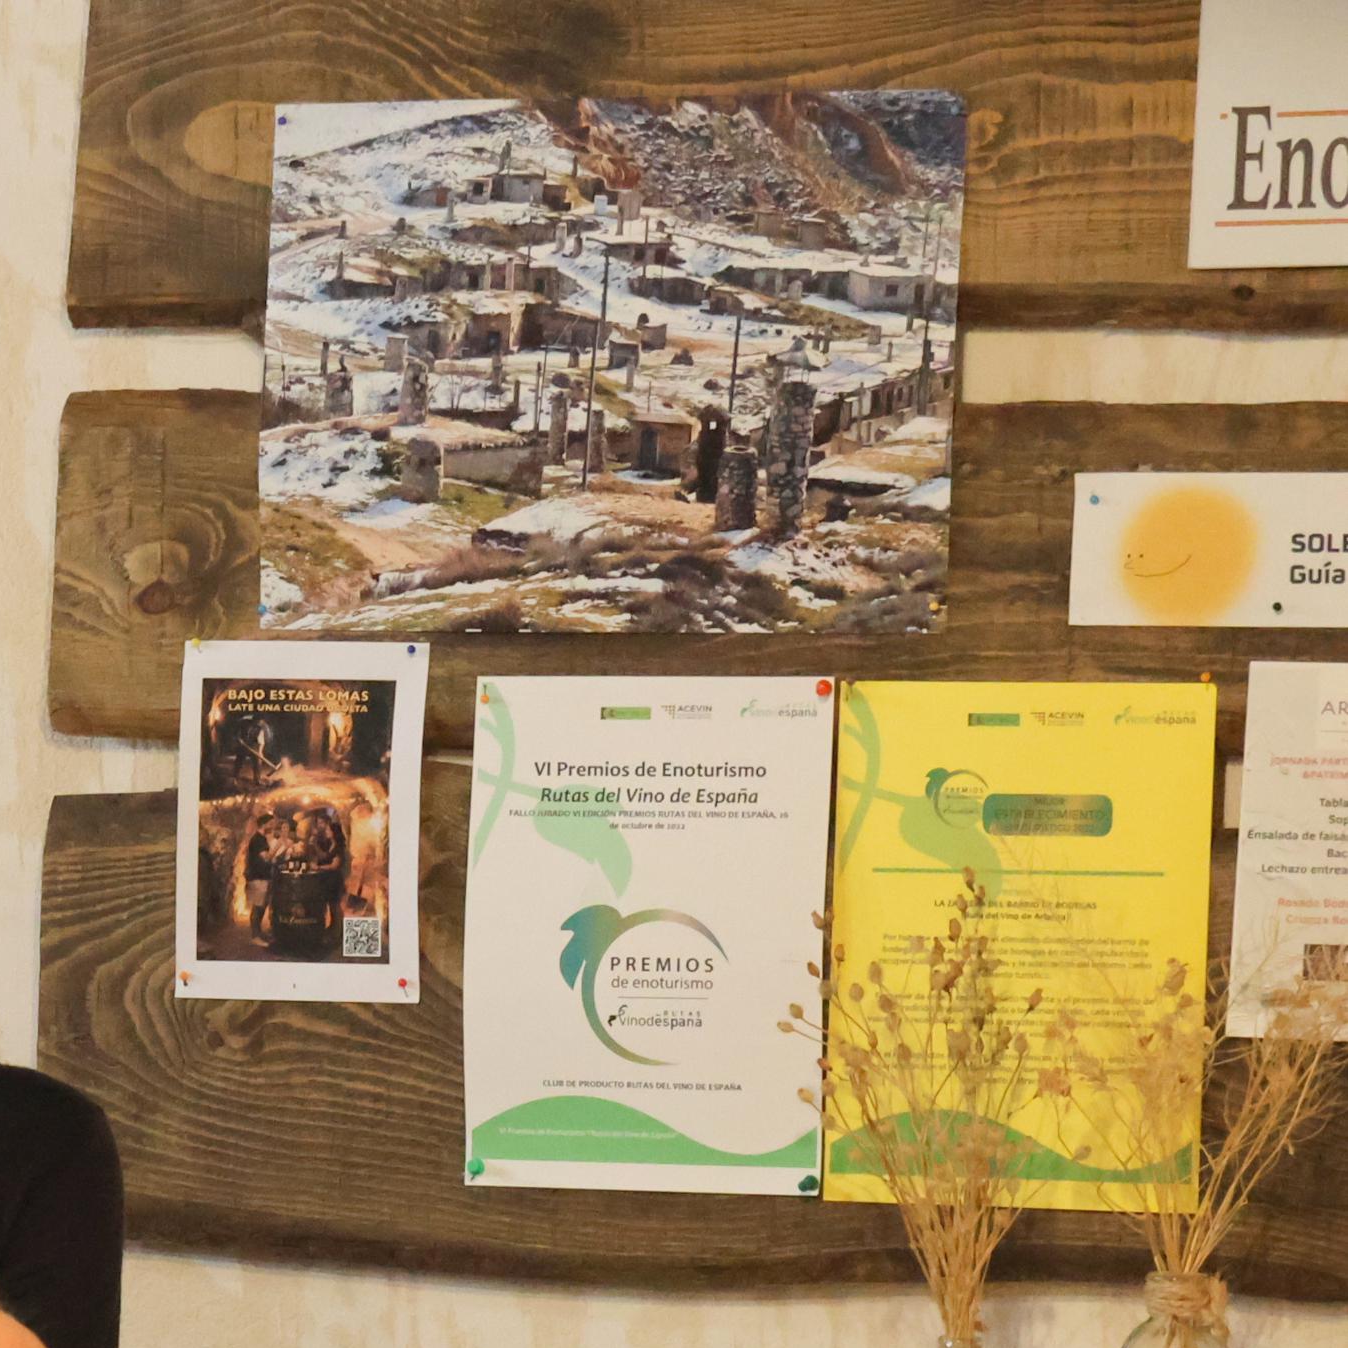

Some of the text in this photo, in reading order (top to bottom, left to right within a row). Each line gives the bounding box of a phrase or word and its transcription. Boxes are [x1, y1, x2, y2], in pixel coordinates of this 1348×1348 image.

[1290, 561, 1346, 584] Guía
[228, 689, 369, 702] BAJO ESTAS LOMAS
[228, 703, 254, 712] LATE
[257, 704, 280, 712] UNA
[283, 704, 323, 713] CIUDAD
[677, 704, 713, 713] ACEVIN
[1321, 701, 1348, 715] AR
[1048, 711, 1085, 719] ACEVIN
[534, 761, 767, 778] VI Premios de Enoturismo
[540, 787, 759, 807] Rutas del Vino de España
[509, 809, 535, 818] FALLO
[618, 809, 656, 818] PREMIOS
[658, 810, 686, 819] RUTAS
[688, 810, 703, 818] DEL
[706, 810, 727, 818] VINO
[728, 810, 740, 818] DE
[609, 822, 619, 830] de
[655, 822, 665, 830] de
[1247, 830, 1299, 841] Ensalada
[1302, 832, 1317, 841] de
[1261, 864, 1307, 874] Lechazo
[610, 957, 714, 973] PREMIOS
[611, 976, 714, 990] de enoturismo
[543, 1079, 564, 1088] CLUB
[566, 1079, 576, 1088] DE
[579, 1080, 624, 1089] PRODUCTO
[627, 1081, 654, 1090] RUTAS
[656, 1081, 672, 1090] DEL
[673, 1082, 694, 1091] VINO
[696, 1082, 707, 1091] DE
